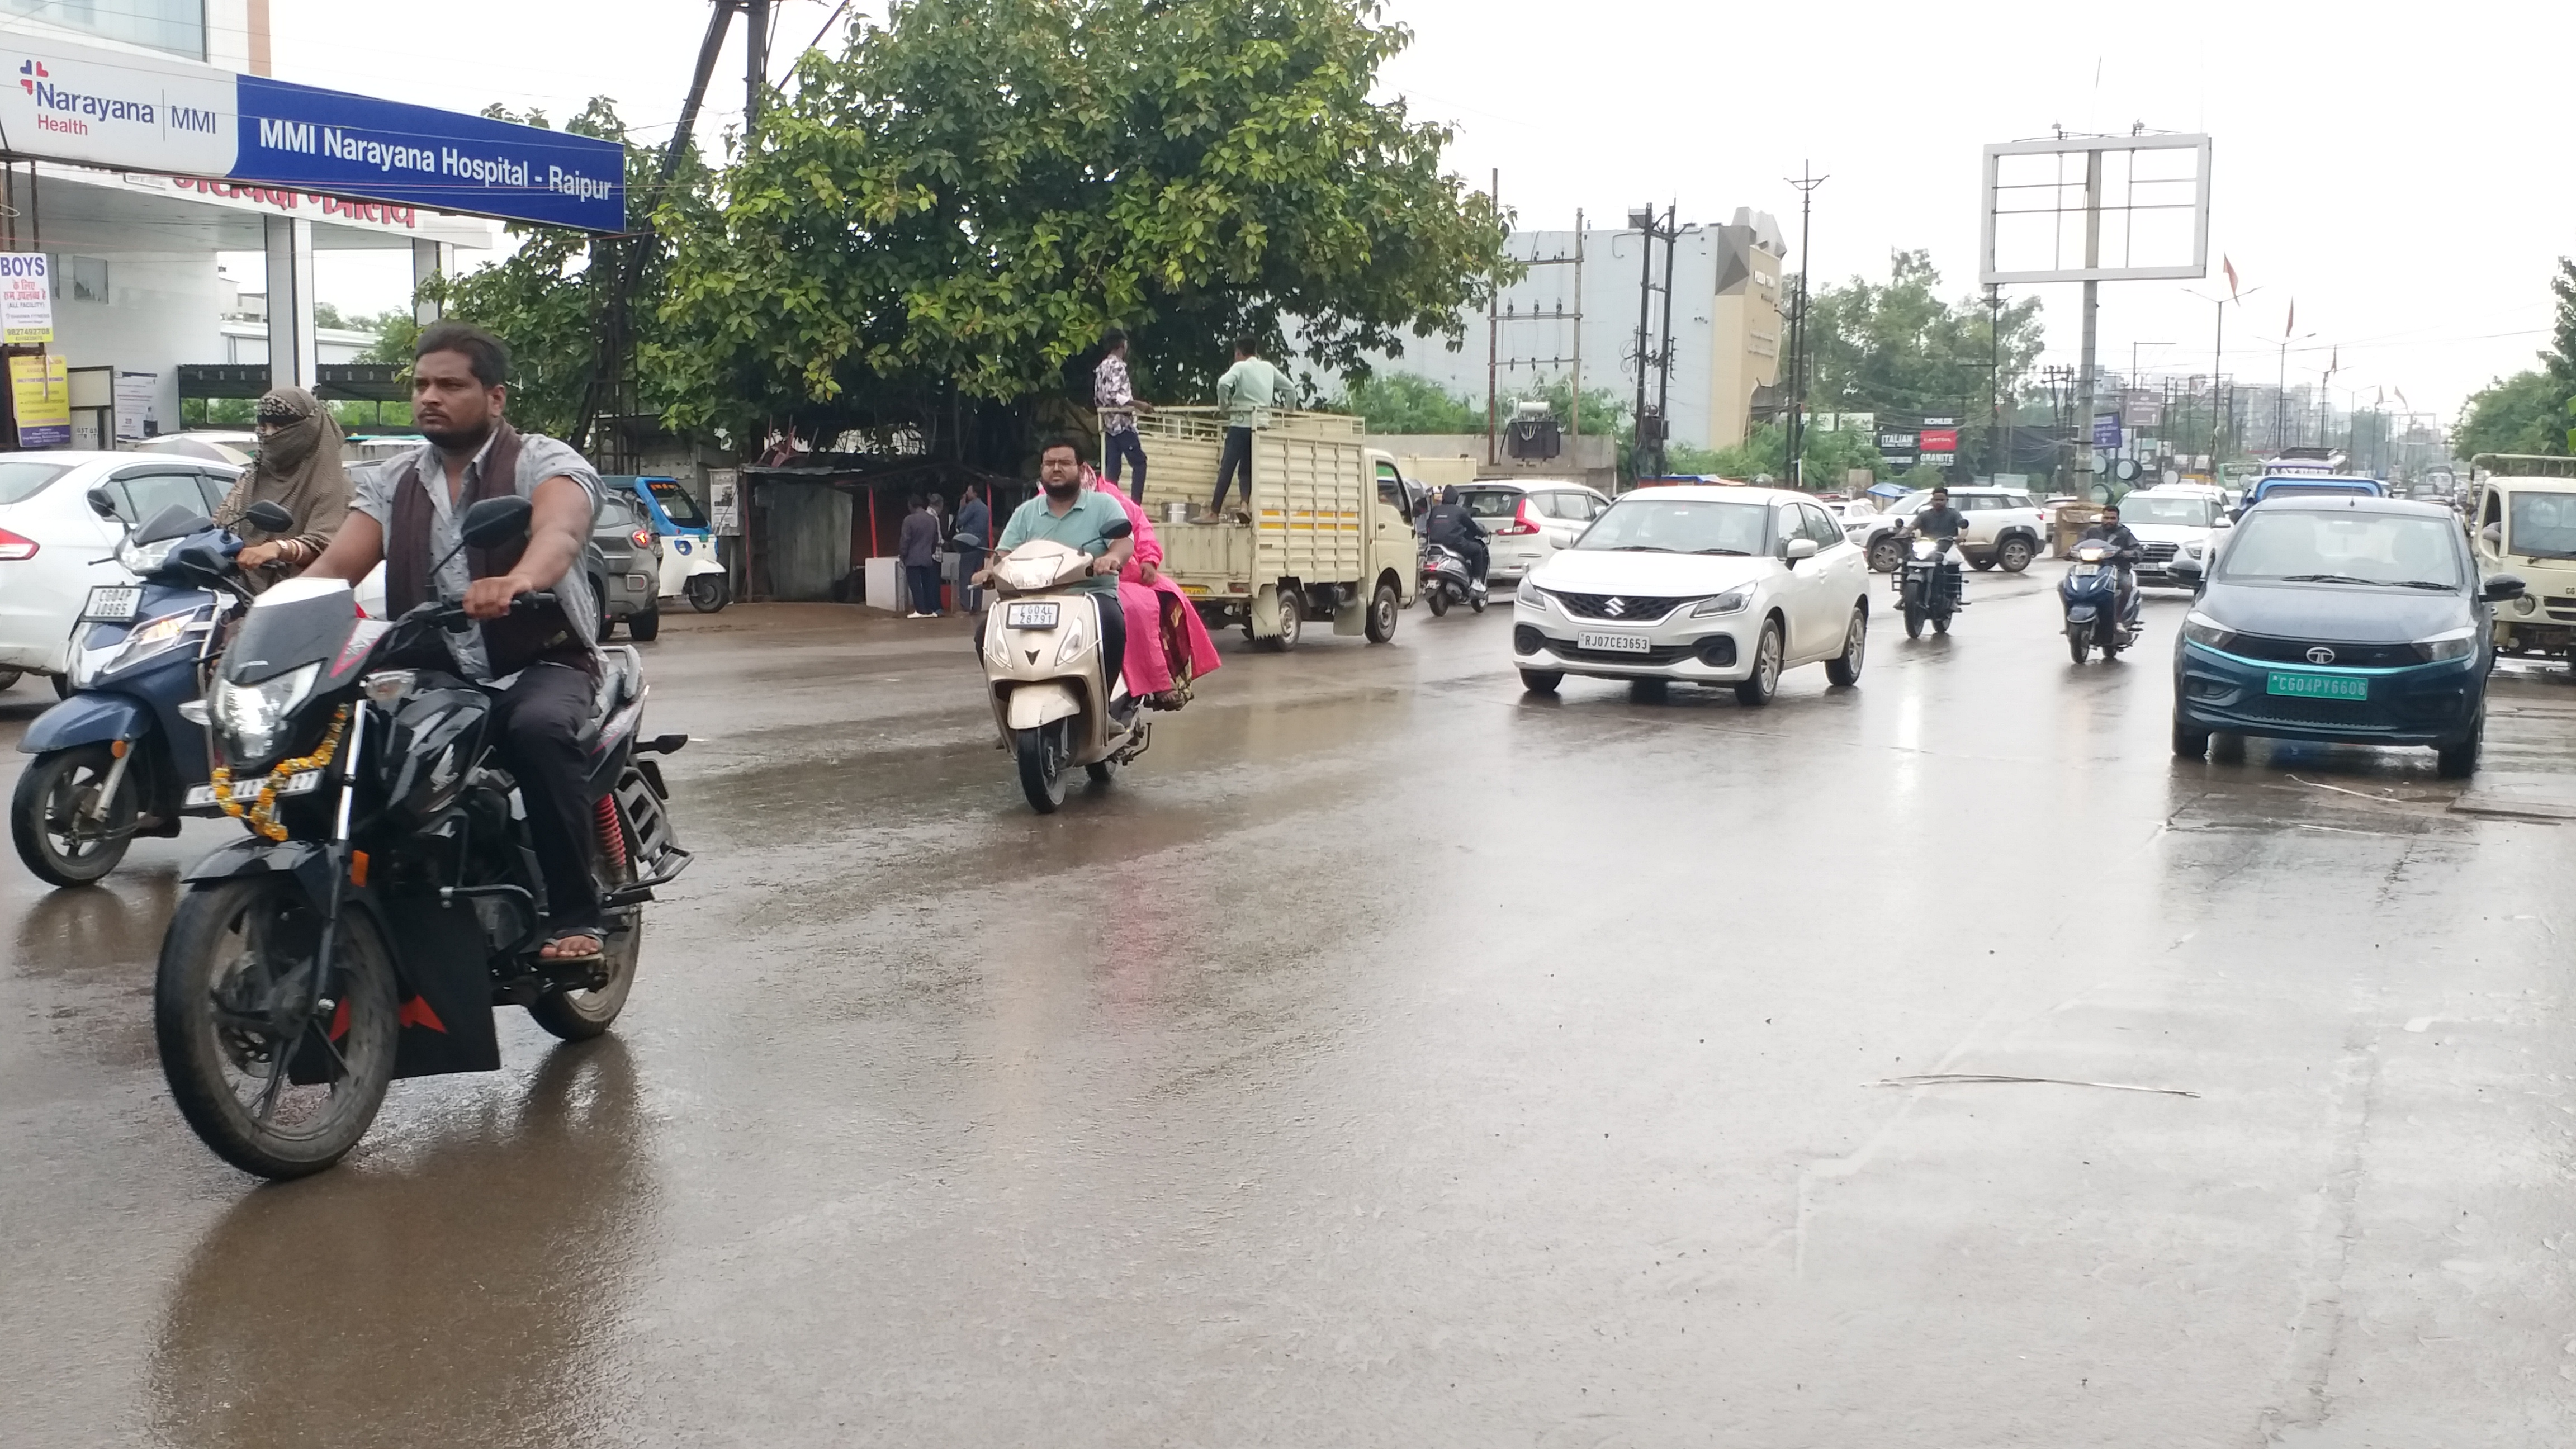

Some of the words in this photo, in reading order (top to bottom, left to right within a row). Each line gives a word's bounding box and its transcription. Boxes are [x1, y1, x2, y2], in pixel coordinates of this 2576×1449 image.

[36, 81, 154, 124] Narayana
[172, 105, 216, 134] MMI
[37, 113, 88, 135] Health
[260, 118, 315, 154] MMI
[324, 127, 435, 173] Narayana
[442, 146, 528, 187] Hospital
[549, 165, 612, 202] Raipur
[0, 257, 45, 277] BOYS
[1920, 453, 1954, 462] GRANITE
[1585, 635, 1647, 650] RJ07CE3653
[2279, 677, 2366, 696] CG04PY6606
